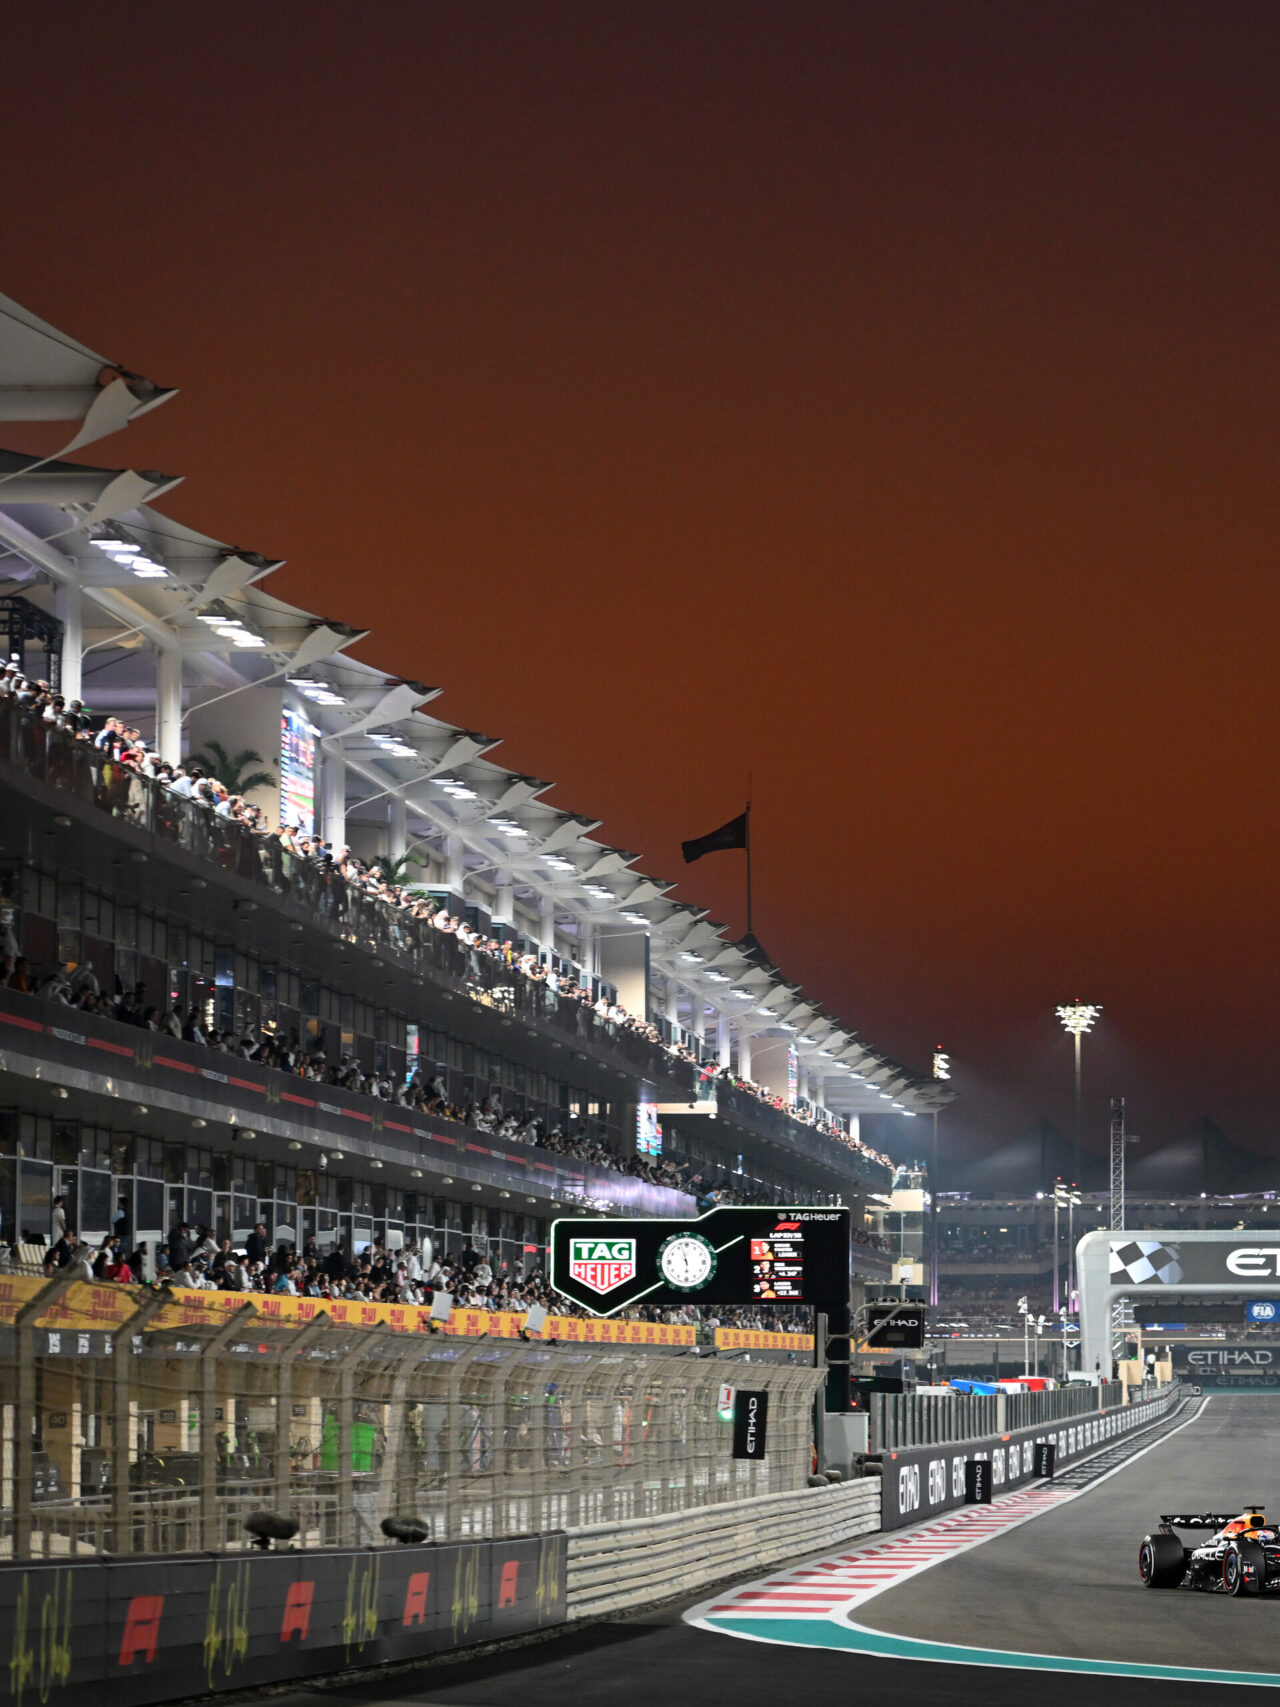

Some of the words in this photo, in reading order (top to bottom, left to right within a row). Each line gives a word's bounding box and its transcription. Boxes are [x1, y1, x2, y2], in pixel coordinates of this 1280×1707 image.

[575, 1243, 629, 1259] TAG
[753, 1246, 760, 1254] 1
[574, 1264, 631, 1289] HEUER
[753, 1265, 760, 1274] 2
[753, 1284, 760, 1293] 3
[1188, 1350, 1273, 1365] ETIHAD
[746, 1397, 758, 1454] ETIHAD
